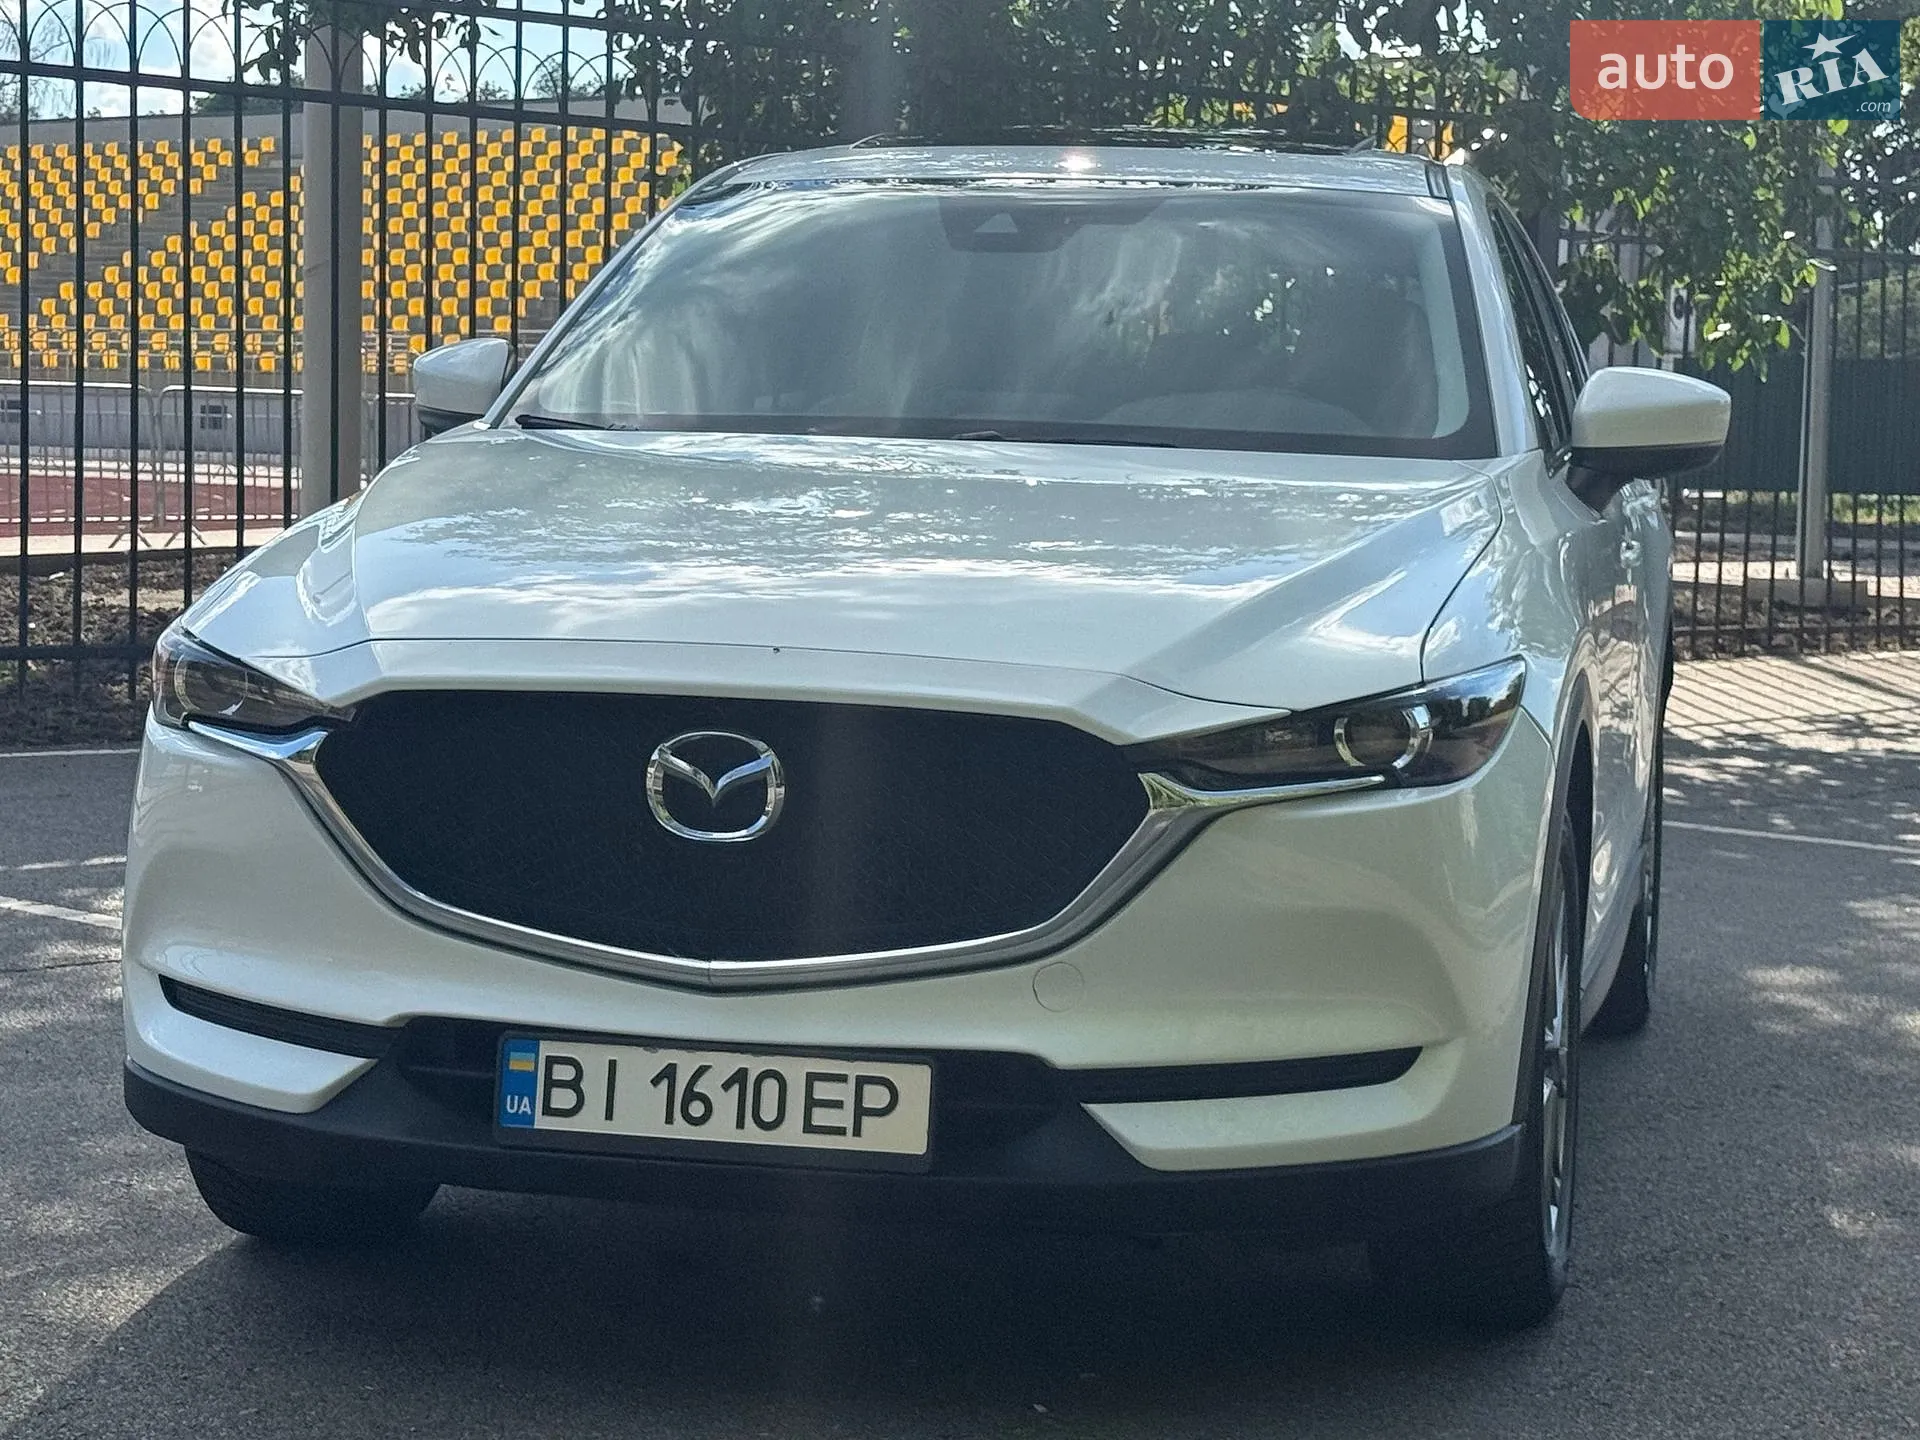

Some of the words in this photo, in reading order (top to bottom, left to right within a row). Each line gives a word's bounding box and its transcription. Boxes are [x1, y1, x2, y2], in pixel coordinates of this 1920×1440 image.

[506, 1095, 532, 1115] UA
[542, 1055, 617, 1121] BI
[650, 1062, 787, 1131] 1610
[802, 1071, 899, 1137] EP
